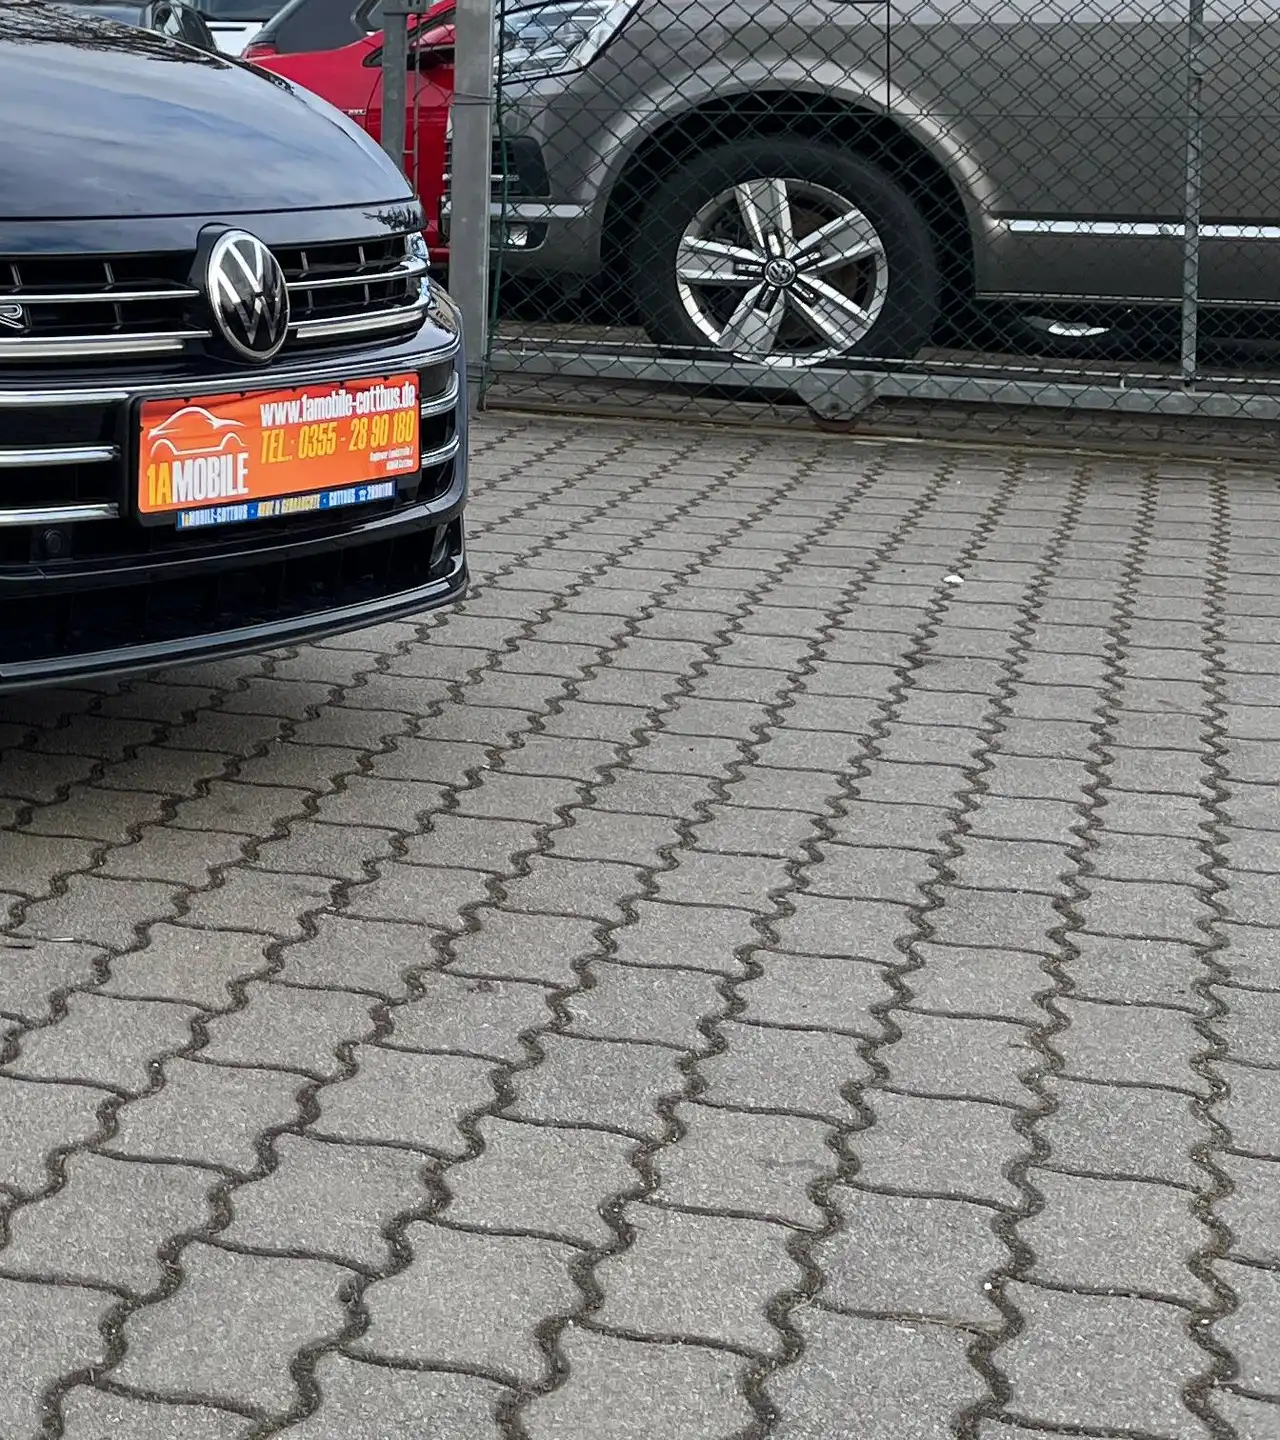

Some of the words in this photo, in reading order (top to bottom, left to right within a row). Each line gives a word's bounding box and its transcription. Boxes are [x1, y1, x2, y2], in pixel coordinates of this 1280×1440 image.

[260, 381, 416, 427] www.1amobile-cottbus.de
[298, 421, 338, 459] 0355
[348, 417, 368, 451] 28
[370, 414, 389, 448] 90
[392, 410, 416, 444] 180
[147, 452, 249, 506] 1AMOBILE
